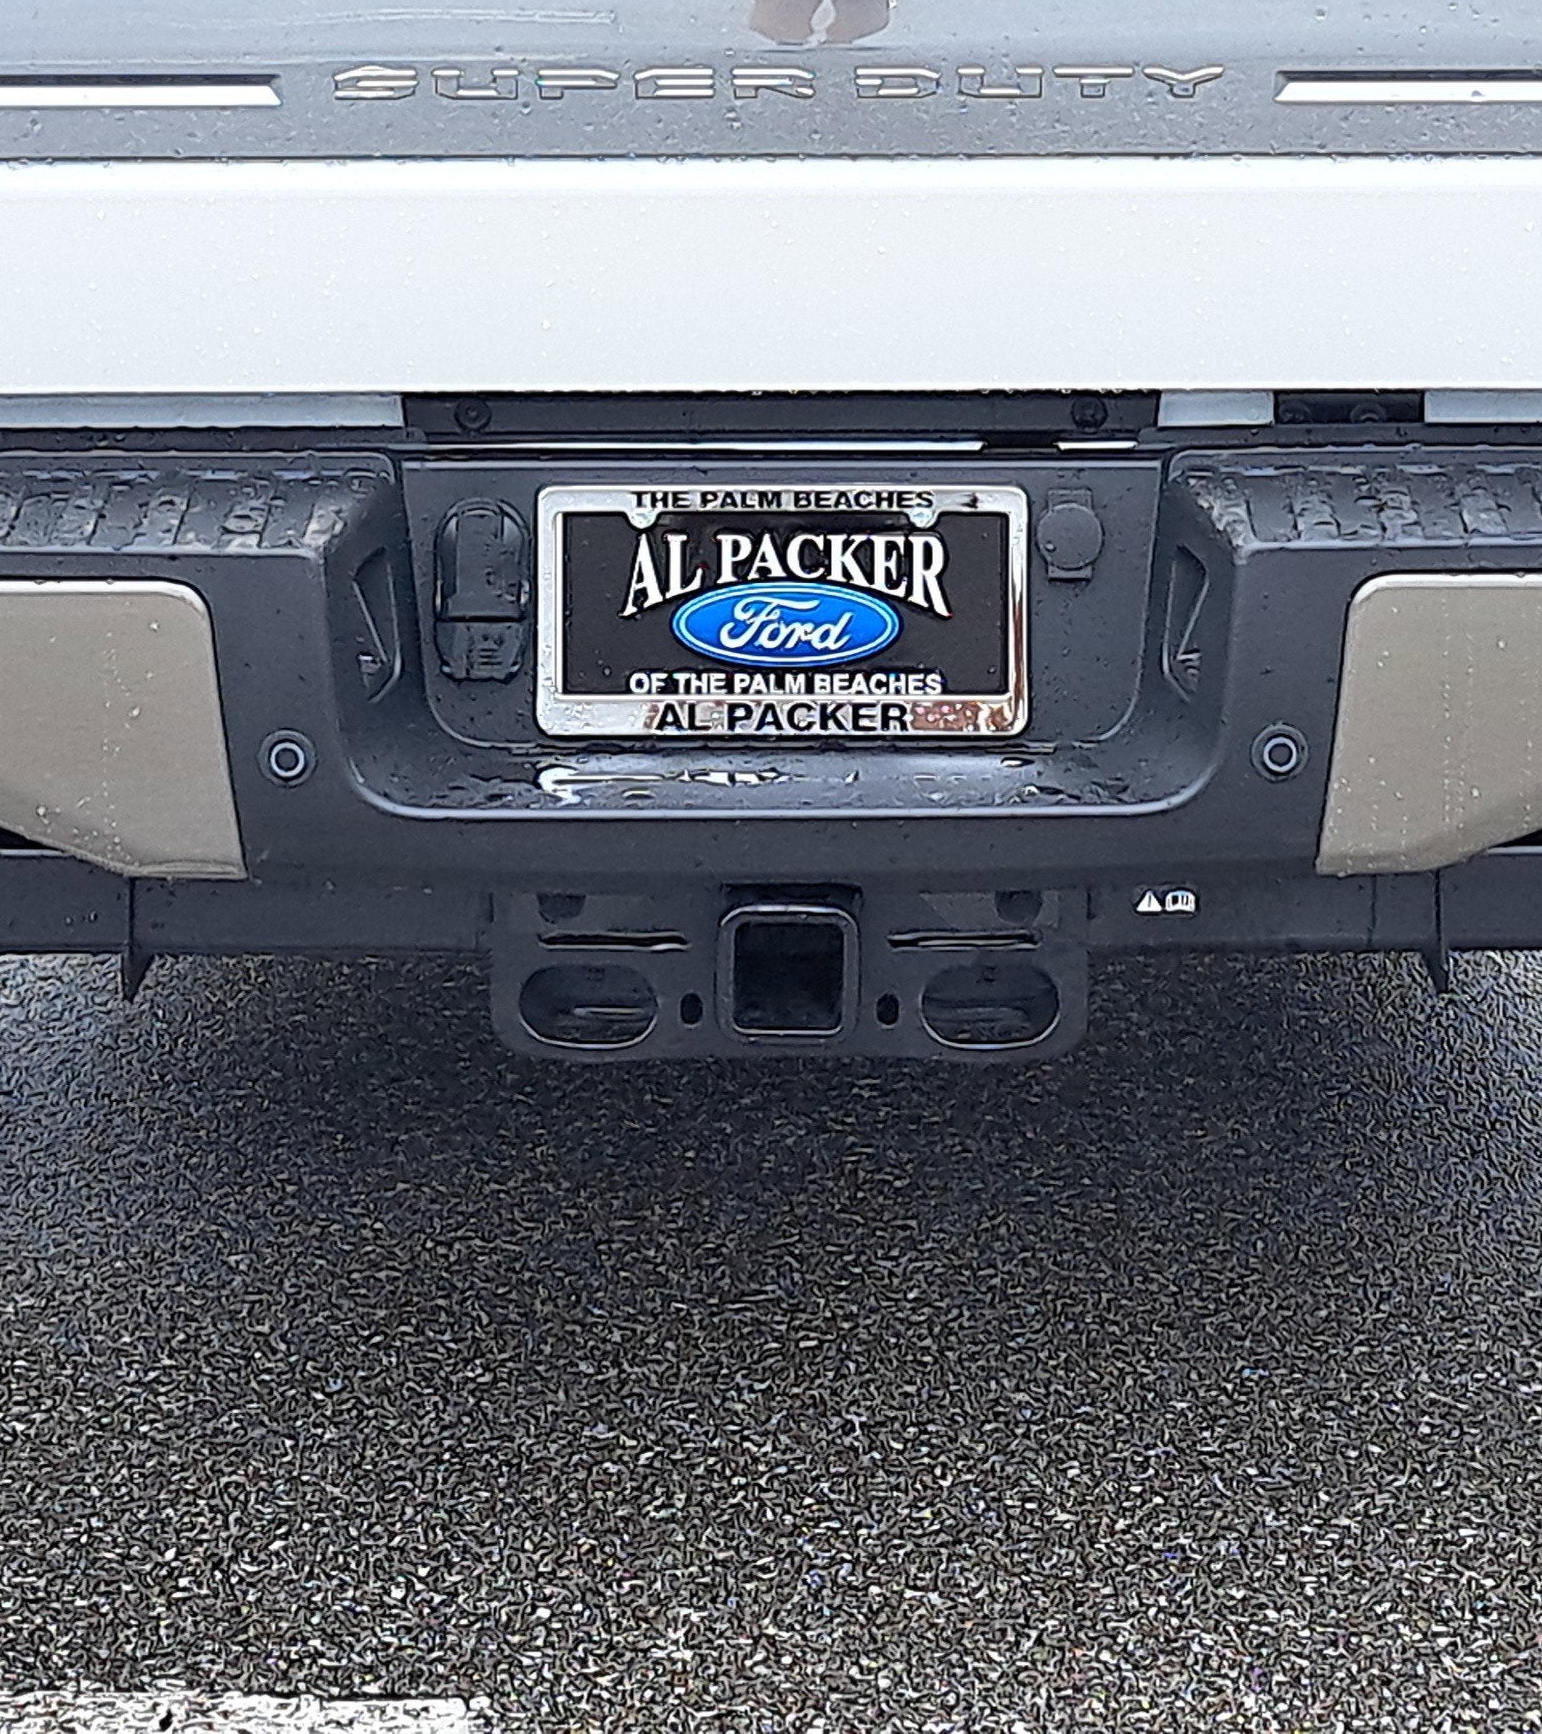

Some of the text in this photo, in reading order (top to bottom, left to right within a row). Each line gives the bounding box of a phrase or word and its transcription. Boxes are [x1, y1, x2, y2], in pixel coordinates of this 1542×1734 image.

[332, 66, 1225, 101] SUPER DUTY
[632, 491, 935, 510] THE PALM BEACHES
[620, 533, 953, 617] AL PACKER
[719, 596, 856, 651] Ford
[629, 673, 943, 696] OF THE PALM BEACHES
[654, 701, 911, 732] AL PACKER
